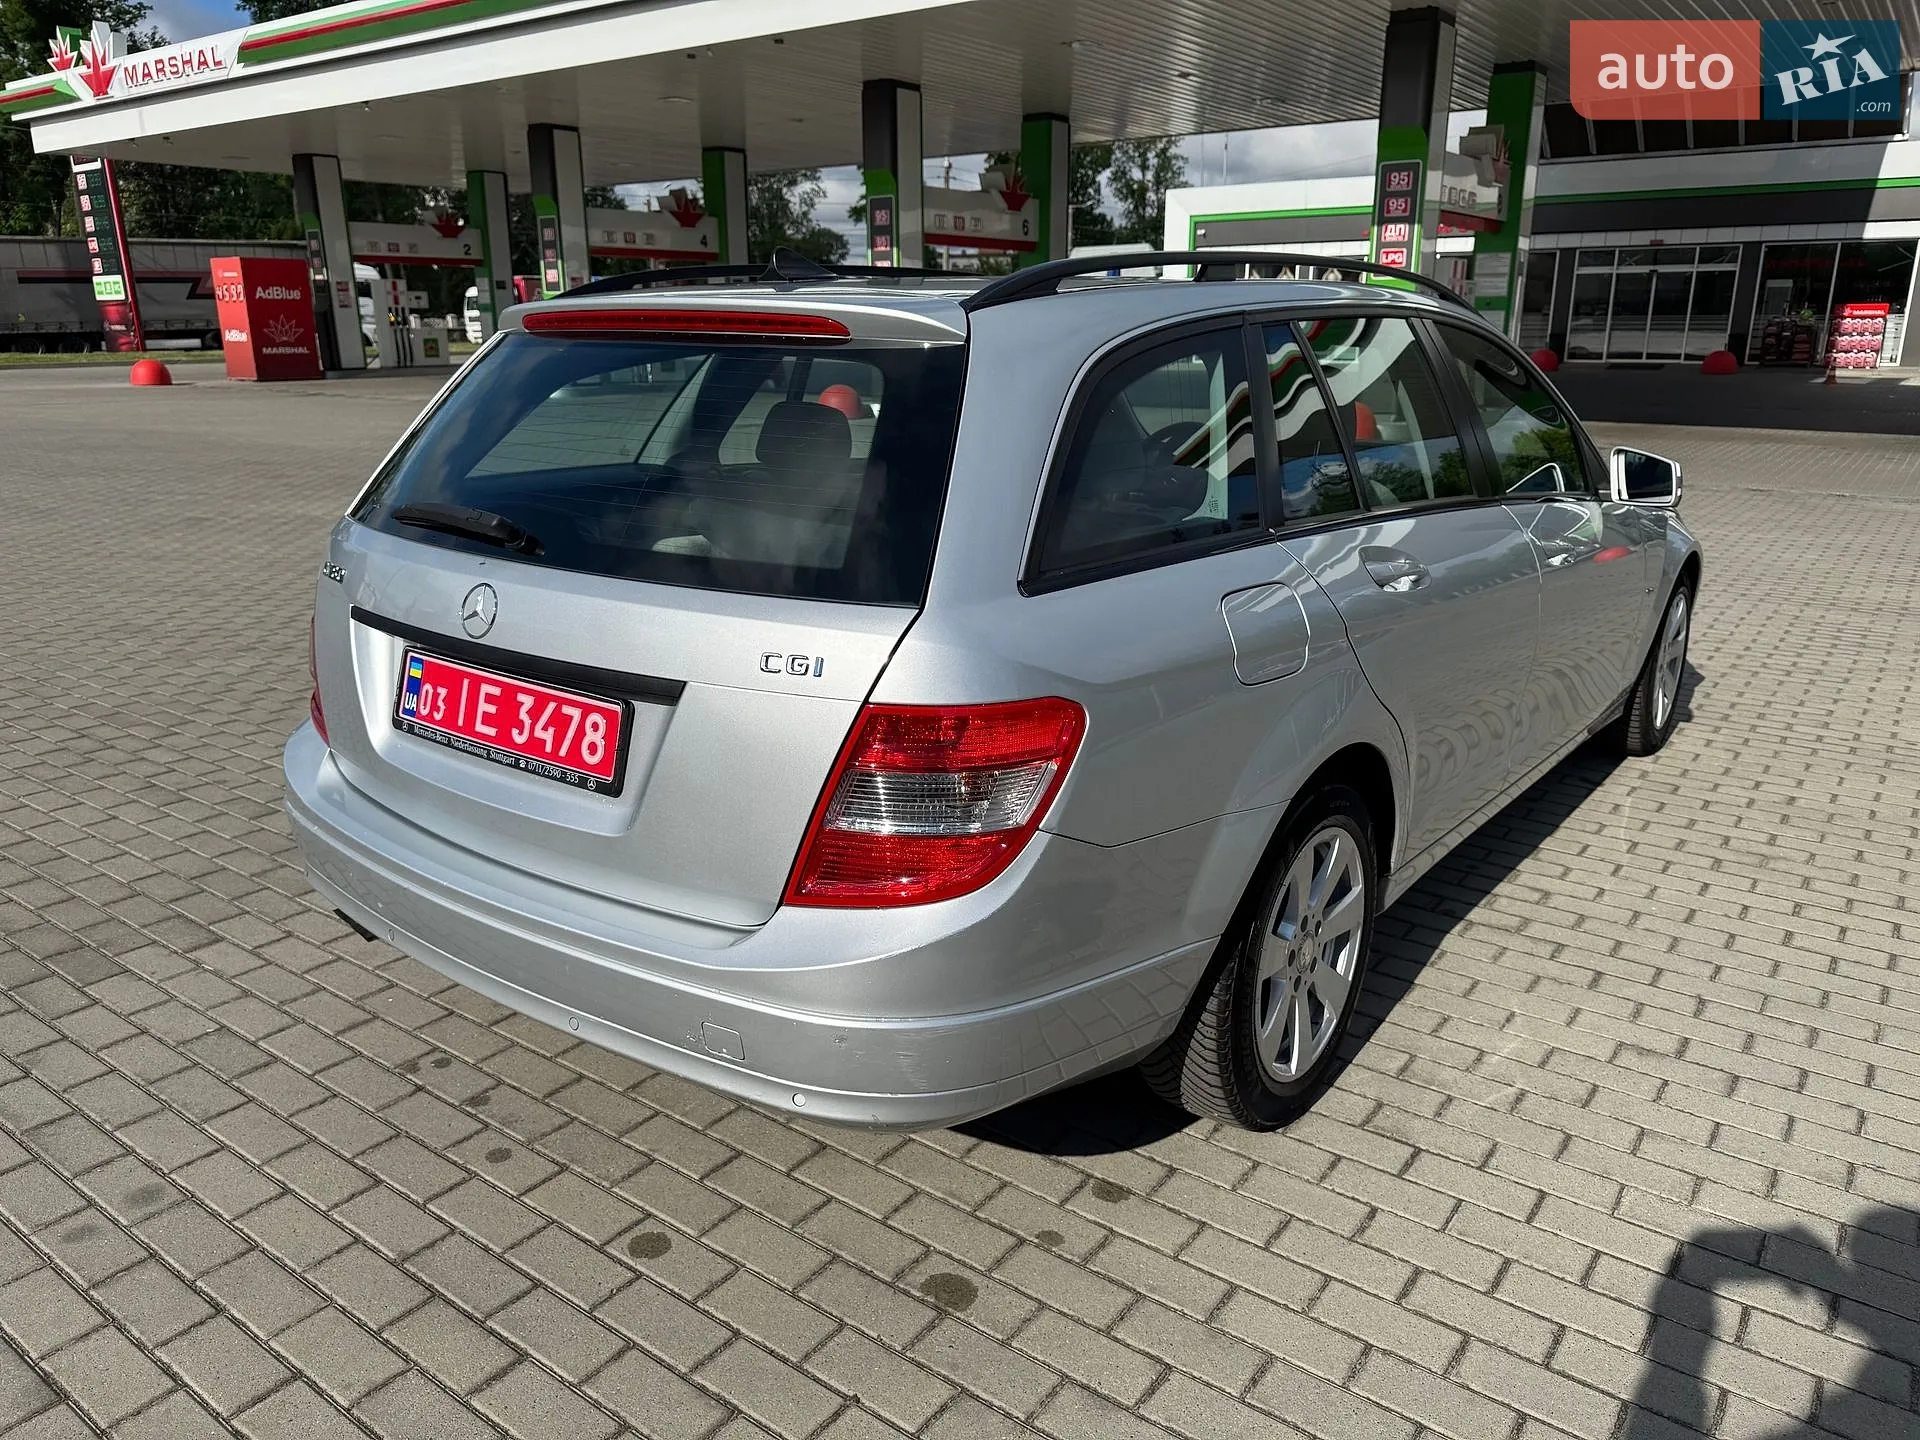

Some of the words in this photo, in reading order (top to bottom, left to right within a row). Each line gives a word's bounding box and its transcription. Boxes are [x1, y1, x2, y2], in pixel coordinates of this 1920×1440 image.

[123, 46, 225, 88] MARSHAL
[1390, 172, 1409, 185] 95
[1389, 198, 1406, 210] 95
[1022, 219, 1030, 236] 6
[700, 233, 708, 248] 4
[463, 243, 472, 256] 2
[1382, 252, 1404, 264] LPG
[255, 286, 301, 300] AdBlue
[262, 346, 310, 355] MARSHAL
[759, 651, 825, 678] CGI
[404, 691, 417, 711] UA
[419, 682, 449, 721] 03
[457, 677, 503, 737] IE
[511, 692, 606, 766] 3478
[414, 724, 449, 744] Mercedes-Benz
[450, 736, 488, 759] Niederlassung
[489, 750, 515, 765] Stuttgart
[528, 761, 561, 778] 0711/2590
[566, 772, 579, 784] 555
